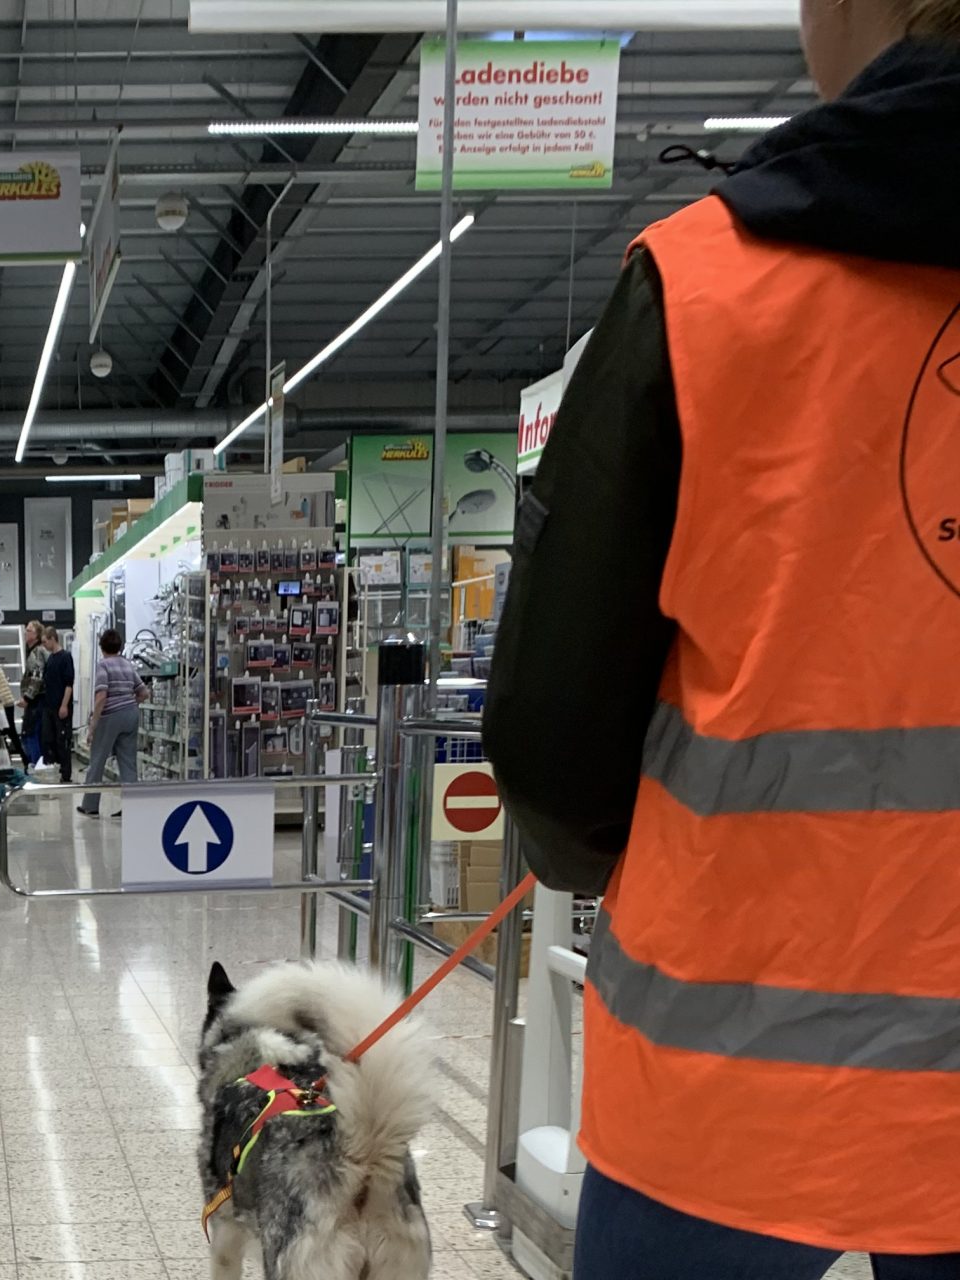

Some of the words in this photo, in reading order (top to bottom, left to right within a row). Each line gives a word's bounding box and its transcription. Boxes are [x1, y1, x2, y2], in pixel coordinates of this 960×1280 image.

[454, 61, 589, 84] adendiebe
[434, 91, 489, 106] wrden
[494, 91, 528, 105] nicht
[533, 90, 602, 109] geschont!
